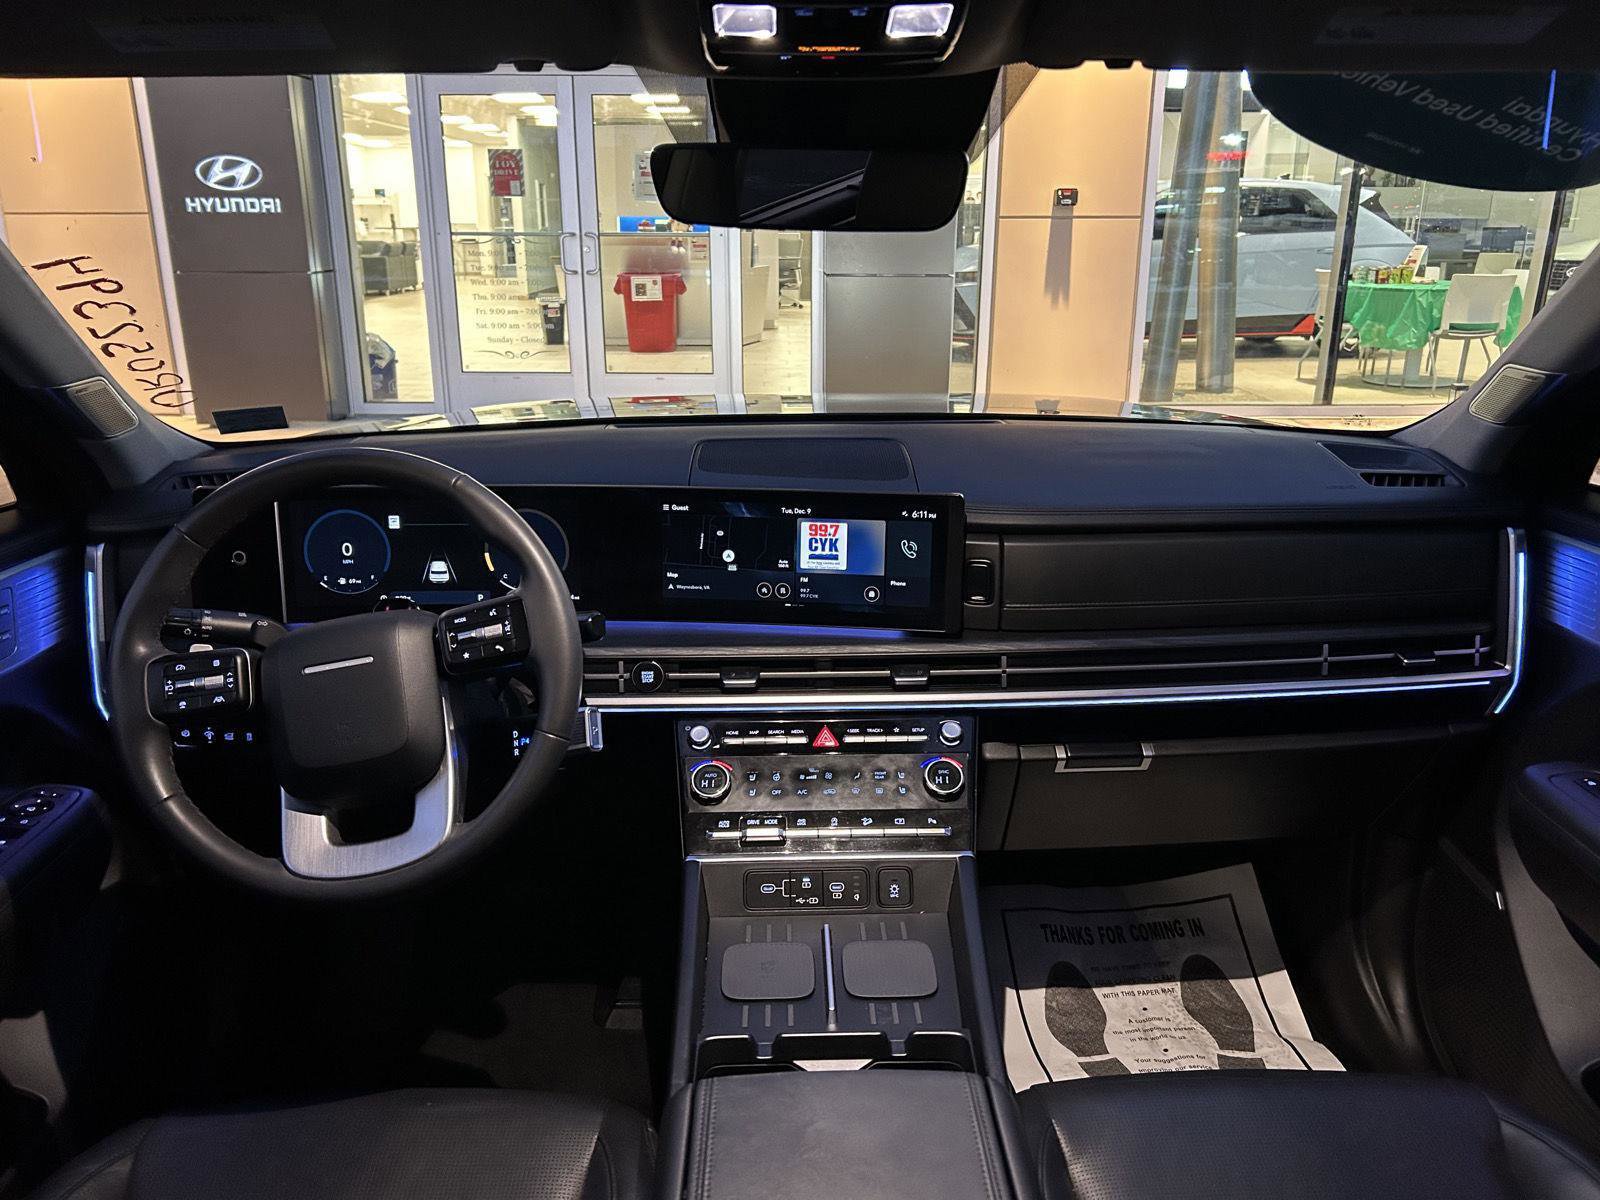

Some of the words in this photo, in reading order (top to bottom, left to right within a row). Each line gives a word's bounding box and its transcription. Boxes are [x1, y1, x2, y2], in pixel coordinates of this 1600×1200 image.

[185, 197, 281, 214] HYUNDAI
[487, 336, 513, 344] Sunday
[671, 504, 689, 512] Guest
[912, 510, 928, 519] 6:11
[808, 524, 840, 538] 99.7
[341, 541, 352, 556] 0
[808, 537, 840, 553] CYK
[1040, 922, 1095, 946] THANKS
[1098, 924, 1127, 945] FOR
[1130, 918, 1186, 942] COMING
[1187, 917, 1206, 938] IN
[1153, 1054, 1195, 1064] suggestions
